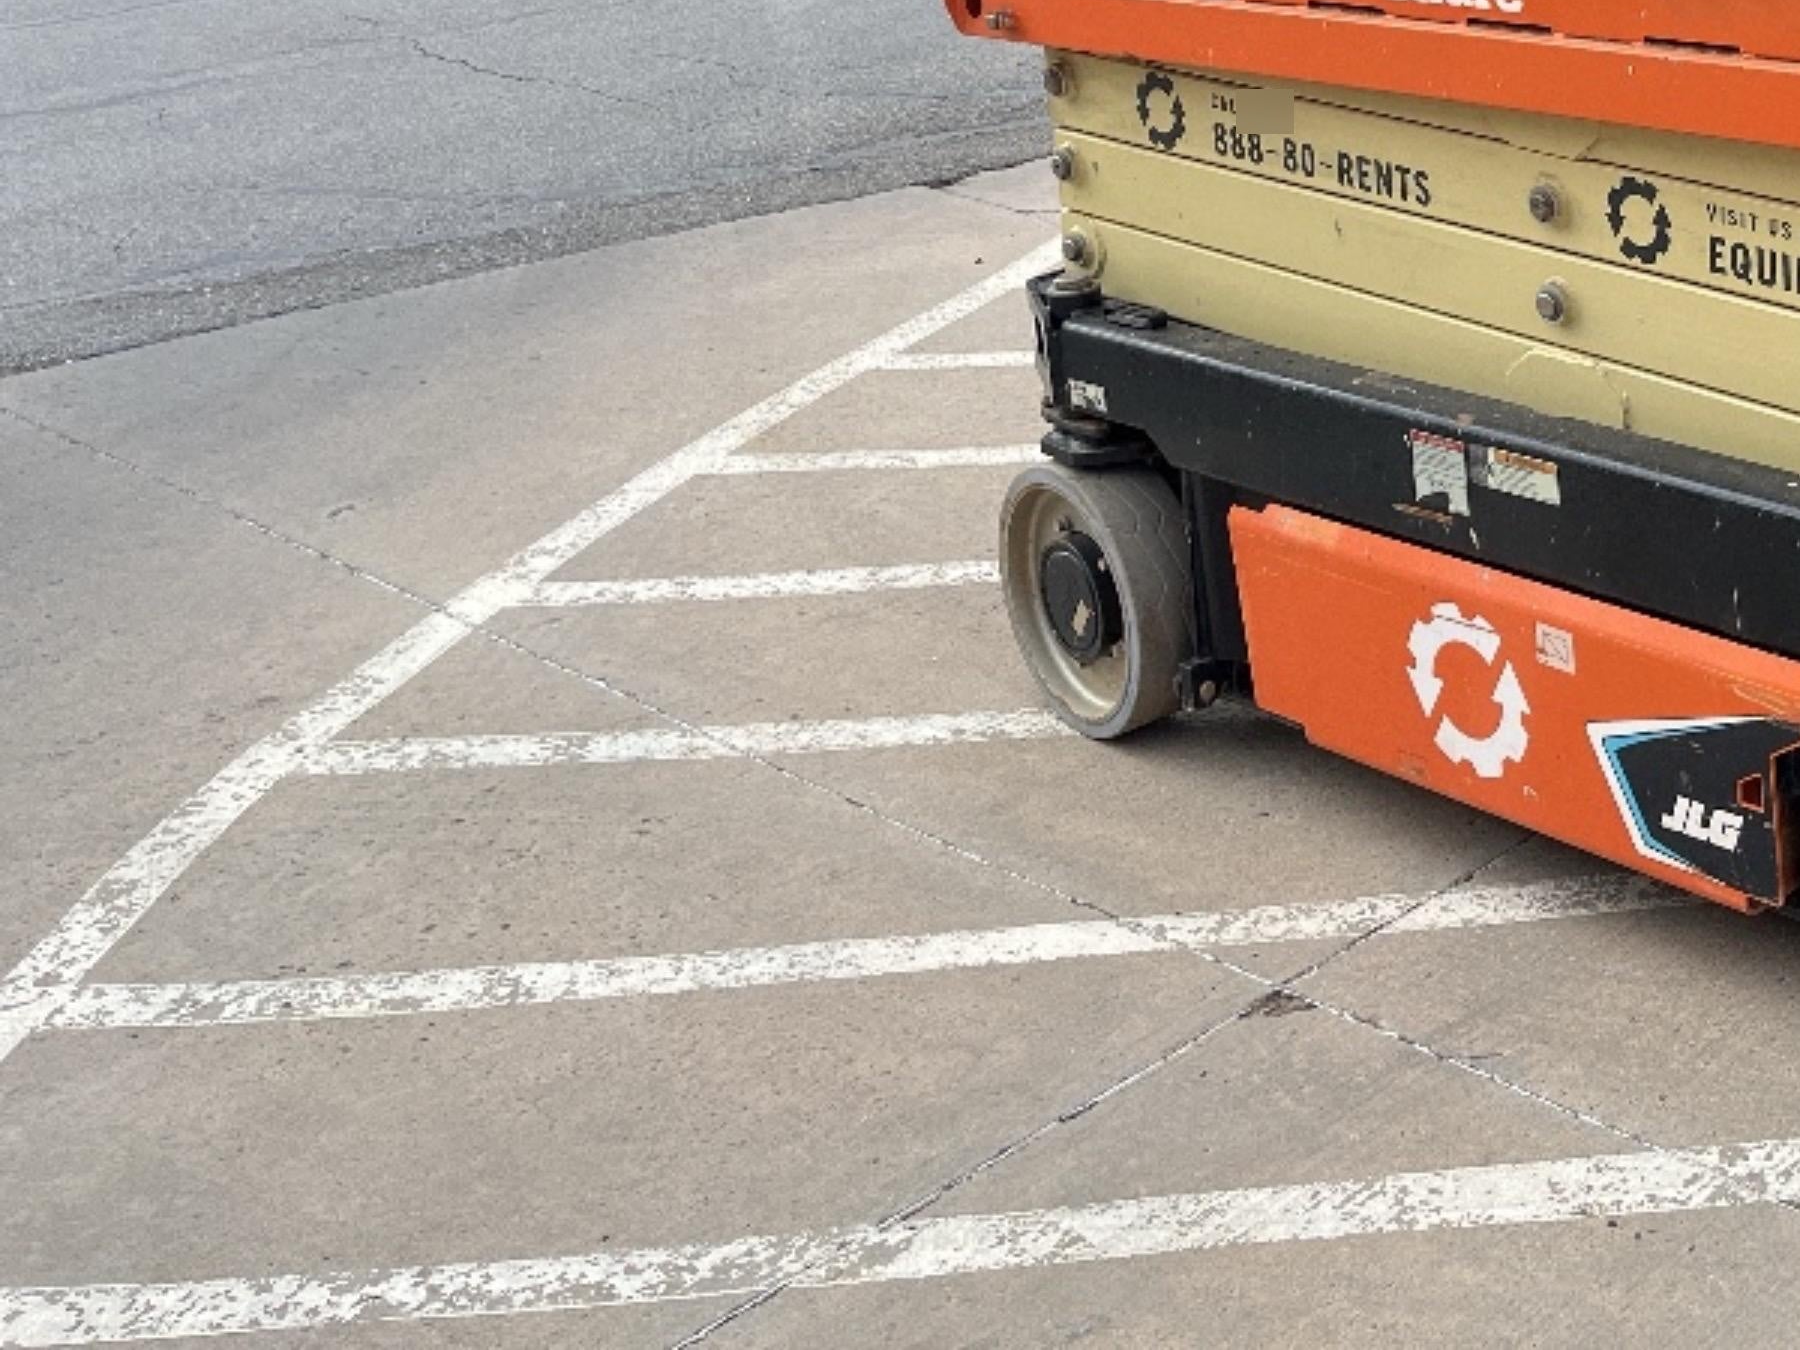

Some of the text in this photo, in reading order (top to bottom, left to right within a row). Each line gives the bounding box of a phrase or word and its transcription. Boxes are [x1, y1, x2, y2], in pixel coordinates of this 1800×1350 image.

[1706, 203, 1758, 232] VISIT
[1769, 217, 1792, 241] US
[1660, 794, 1744, 852] JLG
